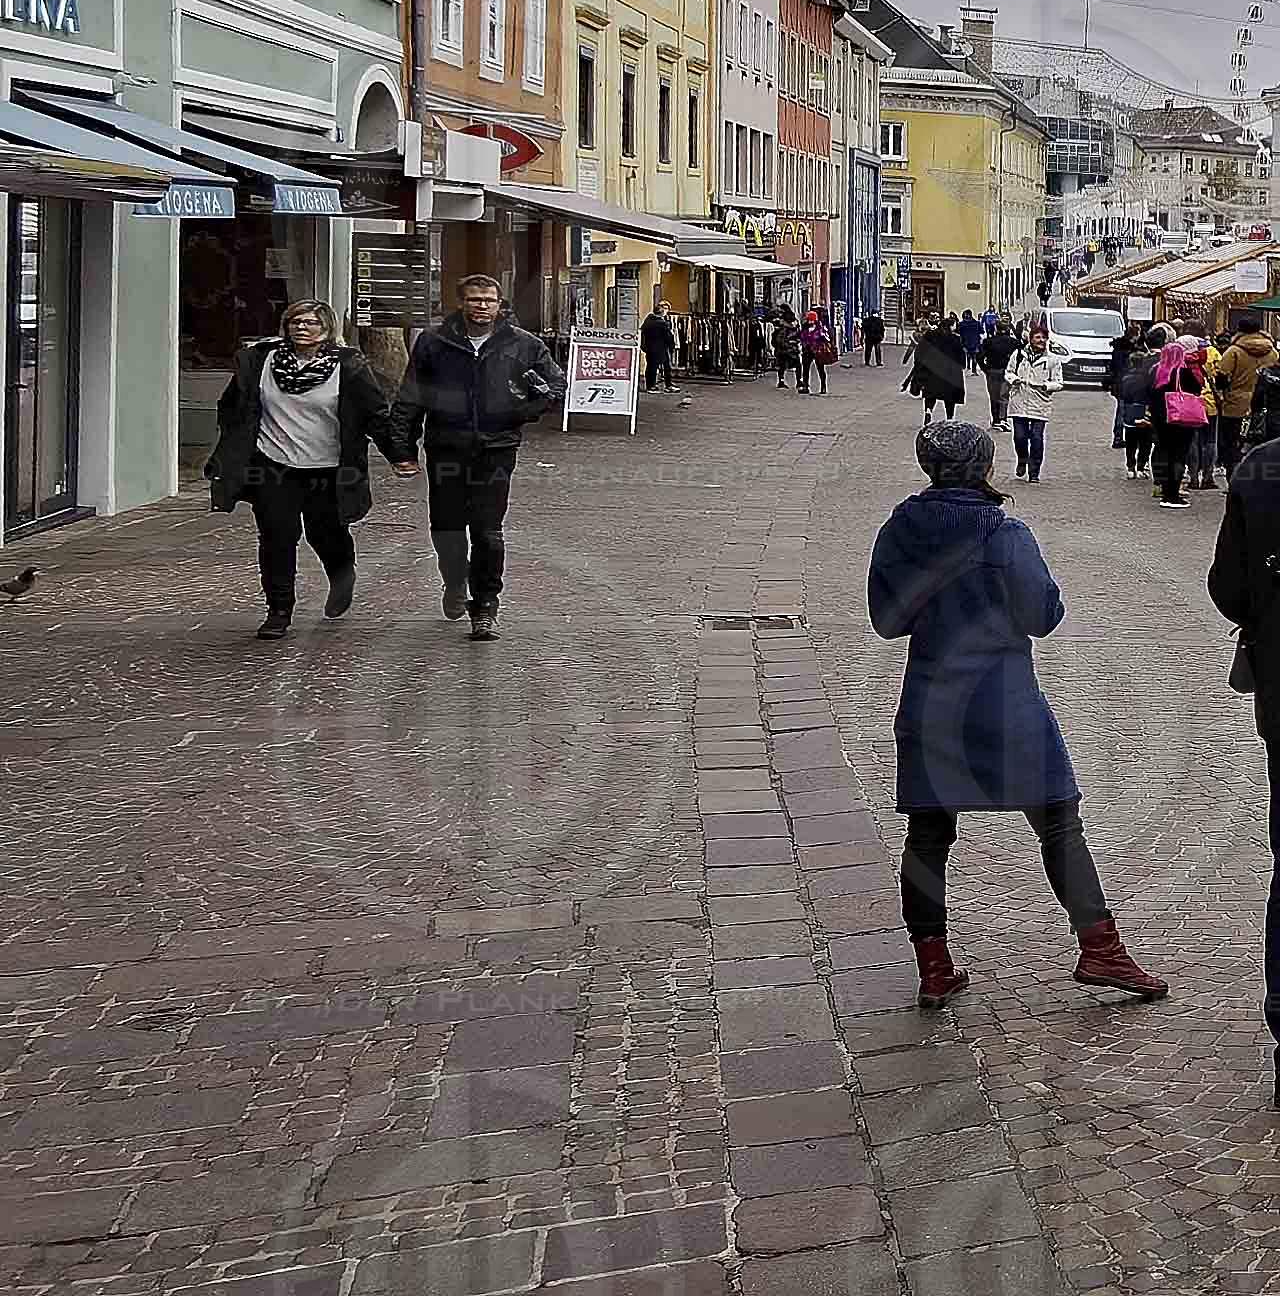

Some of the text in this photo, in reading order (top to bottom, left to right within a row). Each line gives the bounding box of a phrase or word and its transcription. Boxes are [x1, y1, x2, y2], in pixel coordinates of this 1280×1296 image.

[581, 350, 616, 360] FANG
[581, 359, 607, 369] DER
[581, 368, 628, 377] WOCHE
